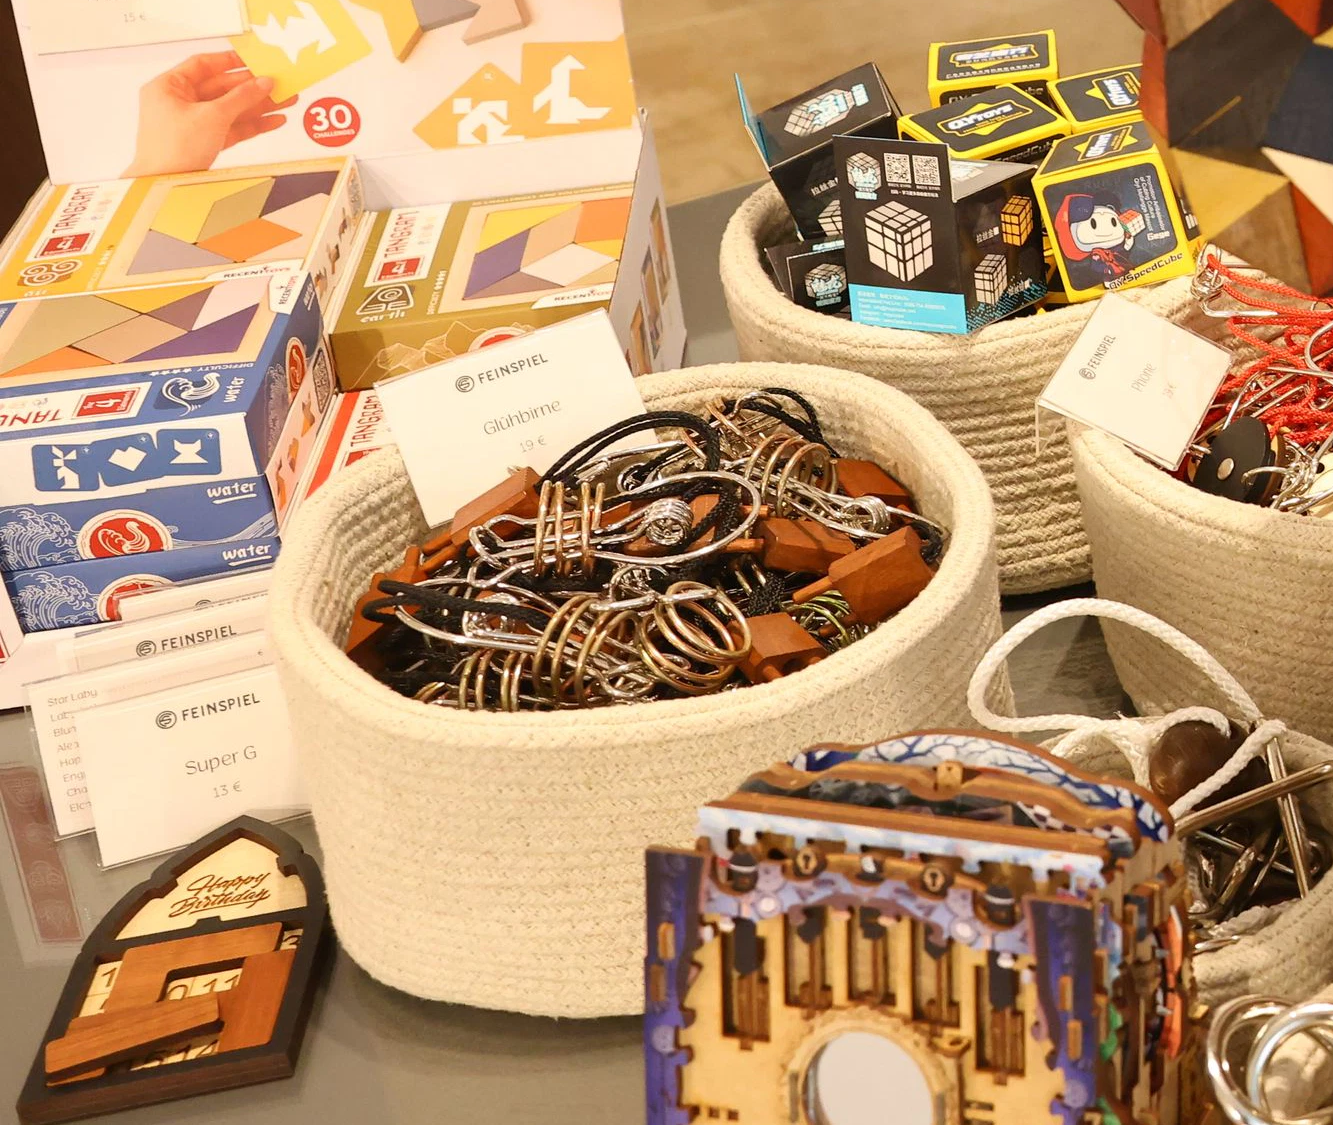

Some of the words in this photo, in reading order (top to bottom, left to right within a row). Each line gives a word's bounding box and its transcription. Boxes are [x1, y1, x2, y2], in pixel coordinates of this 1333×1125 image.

[124, 13, 136, 23] 15
[309, 104, 352, 132] 30
[313, 128, 355, 139] CHALLENGES
[52, 185, 99, 234] TANGRAM
[384, 210, 419, 258] TANGRAM
[1147, 230, 1170, 241] Gege
[224, 266, 291, 278] RECENTTOYS
[1127, 253, 1183, 282] SpeedCube
[360, 309, 406, 323] earth
[1088, 334, 1116, 370] FEINSPIEL
[197, 362, 254, 372] DIFFICULTY
[478, 353, 548, 385] FEINSPIEL
[1131, 362, 1156, 392] Phone
[223, 376, 246, 403] water
[350, 395, 384, 447] TANGRAM
[483, 400, 561, 436] Glühbirne
[520, 439, 534, 453] 19
[537, 435, 547, 447] €
[207, 481, 256, 498] water
[222, 543, 272, 560] water
[162, 625, 237, 651] FEINSPIEL
[47, 696, 69, 707] Star
[182, 692, 261, 722] FEINSPIEL
[185, 751, 240, 776] Super
[243, 745, 257, 761] G
[213, 785, 229, 799] 13
[232, 780, 242, 793] €
[187, 872, 271, 893] Happy
[168, 887, 272, 918] Birthday
